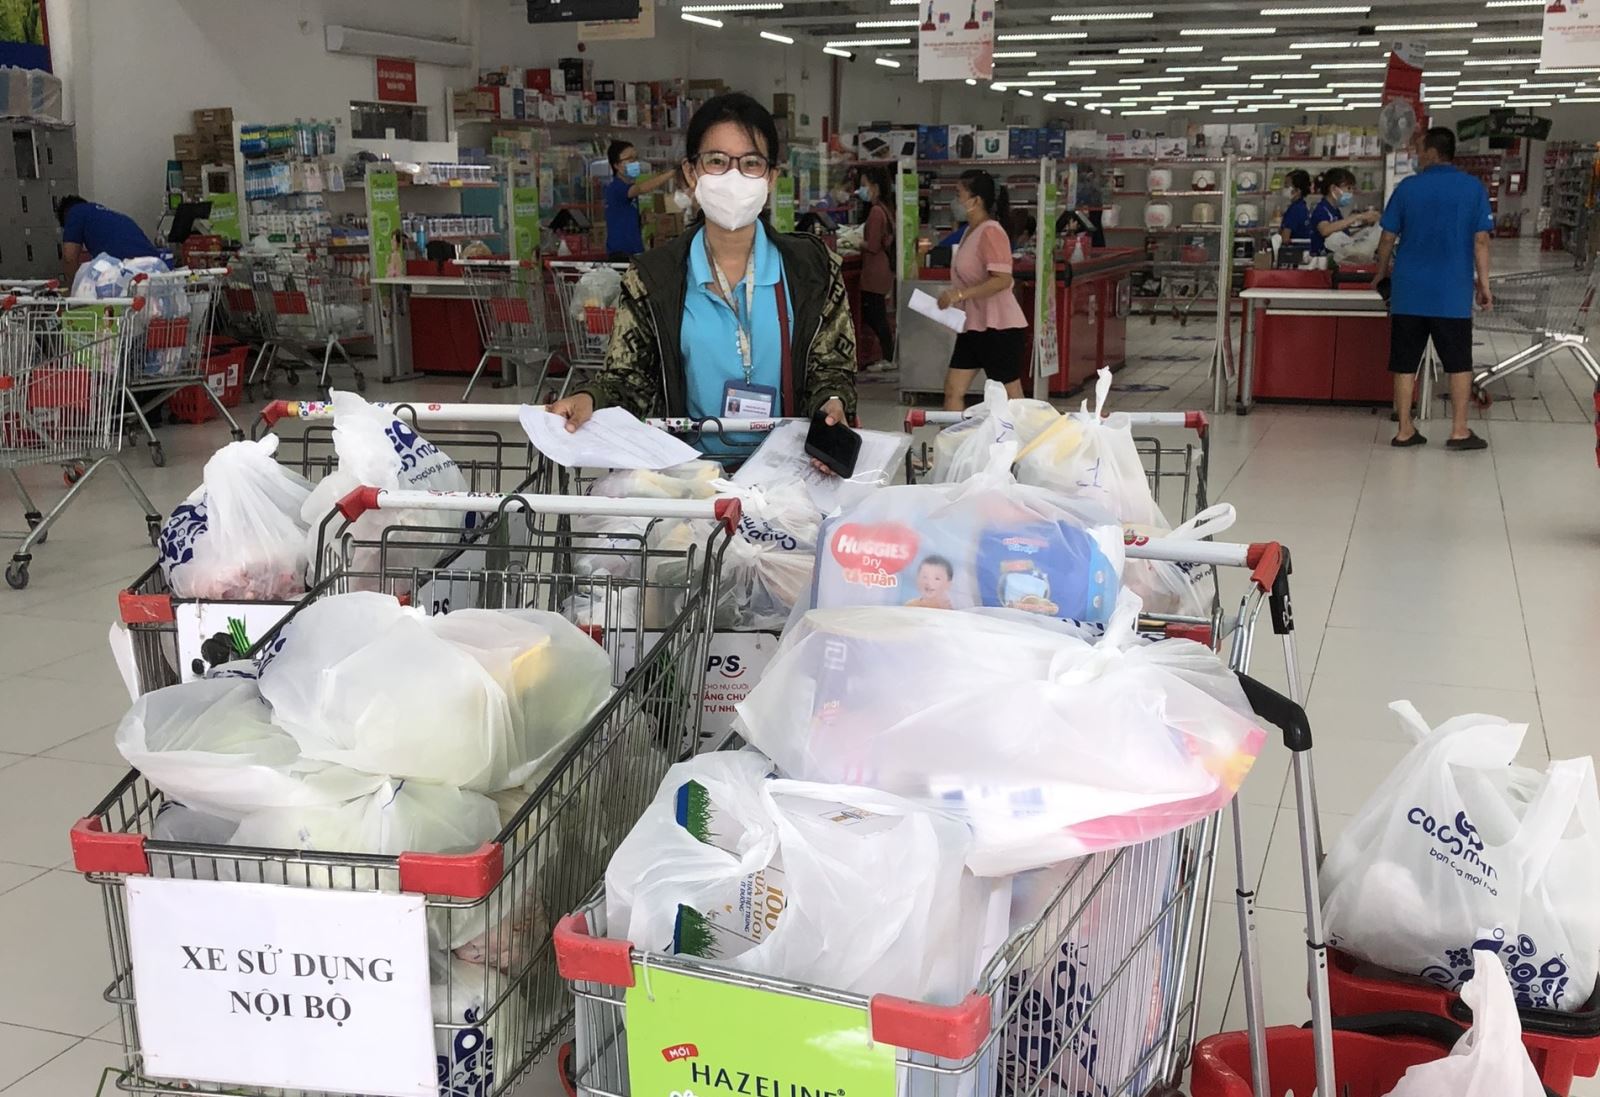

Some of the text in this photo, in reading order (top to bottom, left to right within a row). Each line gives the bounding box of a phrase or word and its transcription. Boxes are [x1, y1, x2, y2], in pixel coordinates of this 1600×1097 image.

[837, 534, 911, 560] HUGGIES
[862, 555, 882, 570] Dry
[862, 568, 897, 588] quần
[706, 655, 741, 673] P/S
[692, 691, 746, 701] TẮNG CHU
[1429, 847, 1483, 886] bạn ca mọi
[752, 901, 764, 940] TƯƠI
[765, 885, 785, 931] 100
[181, 943, 395, 985] XE SỬ DỤNG
[228, 988, 352, 1028] NỘI BỘ
[669, 1046, 691, 1059] MỚI
